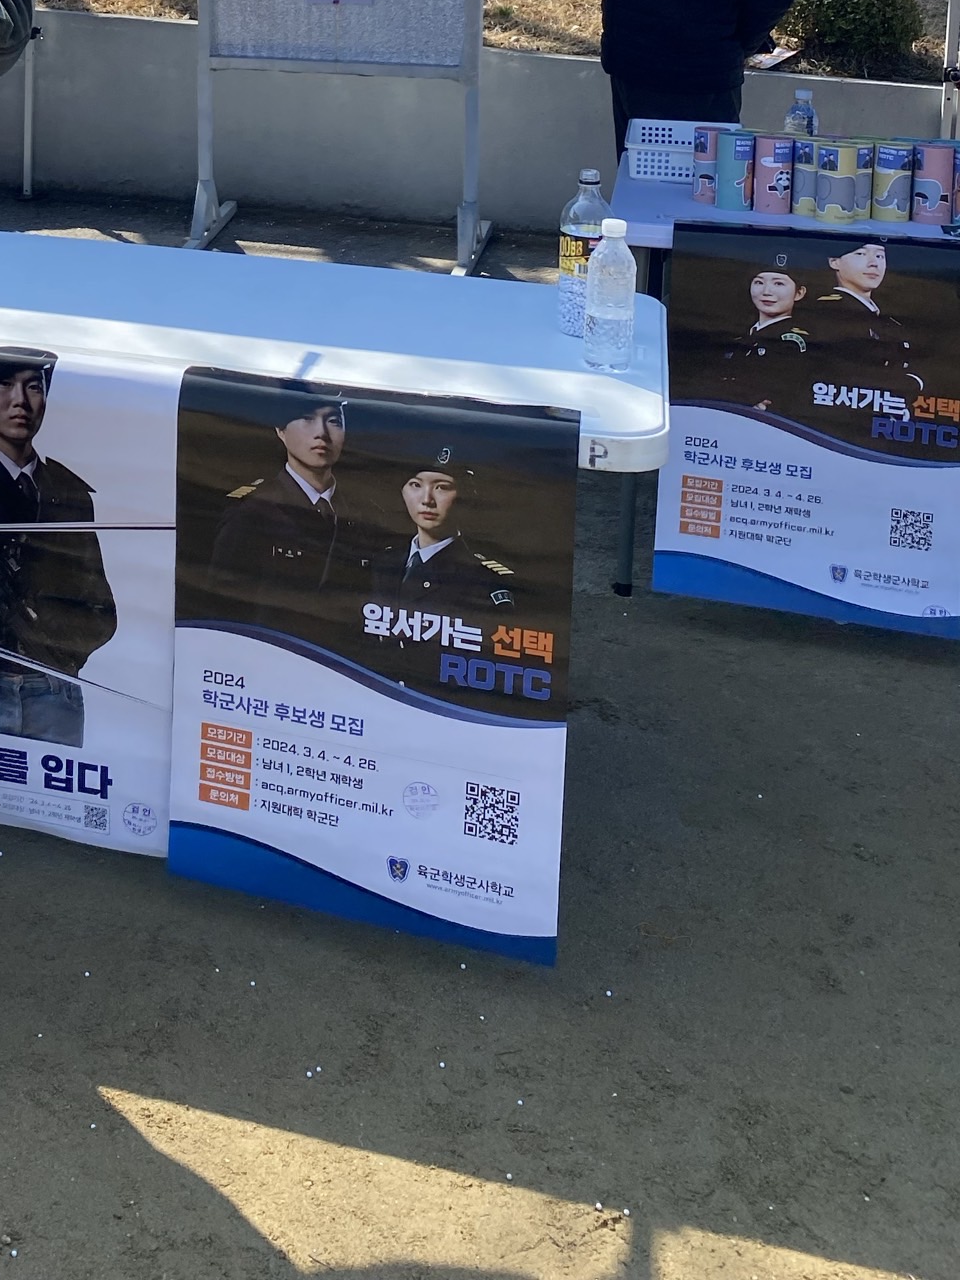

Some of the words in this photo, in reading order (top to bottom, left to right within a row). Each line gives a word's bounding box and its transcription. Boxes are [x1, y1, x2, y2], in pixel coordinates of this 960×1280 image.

[812, 382, 906, 415] 앞서가는
[684, 436, 718, 449] 2024
[871, 416, 959, 449] ROTC
[684, 450, 737, 470] 학군사관
[741, 458, 782, 476] 후보생
[785, 464, 813, 480] 모집
[361, 602, 483, 652] 앞서가는
[490, 624, 554, 664] 선택
[203, 669, 246, 689] 2024
[440, 652, 552, 701] ROTC
[202, 689, 269, 718] 학군사관
[274, 702, 326, 729] 후보생
[329, 713, 364, 737] 모집
[207, 726, 246, 744] 모집기간
[41, 754, 113, 800] 입다
[206, 747, 246, 765] 모집대상
[262, 758, 283, 773] 남녀
[296, 765, 327, 782] 2학년
[330, 771, 364, 790] 재학생
[205, 767, 245, 785] 접수방법
[261, 781, 394, 817] acq.armyofficer.mil.kr
[208, 788, 239, 805] 문의처
[260, 799, 303, 819] 지원대학
[306, 809, 339, 828] 학군단
[417, 864, 515, 898] 육군학생군사학교
